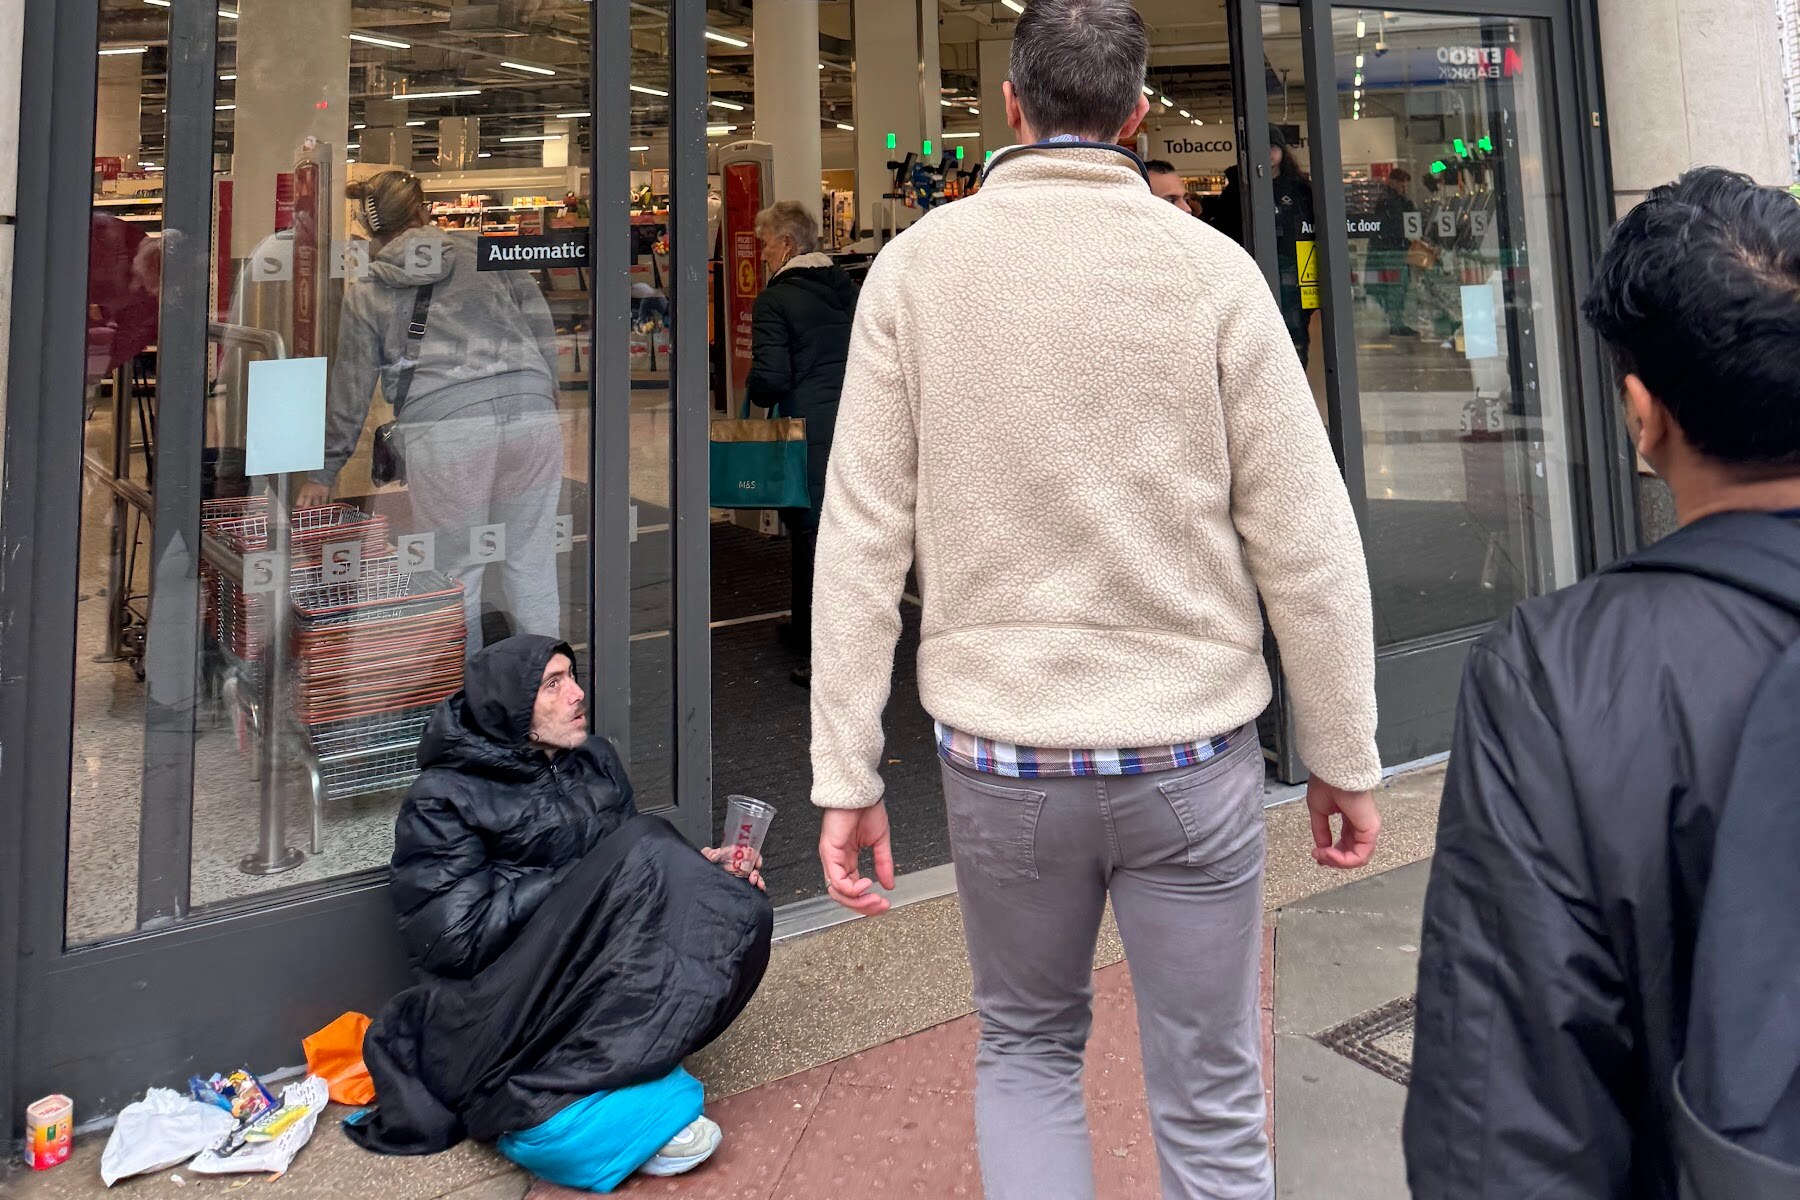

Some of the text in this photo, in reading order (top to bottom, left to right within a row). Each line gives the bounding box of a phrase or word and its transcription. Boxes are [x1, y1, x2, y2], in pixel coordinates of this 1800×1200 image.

[1163, 138, 1233, 154] Tobacco
[1358, 218, 1381, 232] door
[1408, 214, 1485, 234] S S S
[414, 243, 433, 268] S
[488, 241, 586, 262] Automatic
[1490, 410, 1500, 428] S
[738, 480, 756, 489] M&S
[252, 558, 273, 586] S
[330, 549, 351, 576] S
[406, 539, 426, 567] S
[479, 530, 497, 557] S
